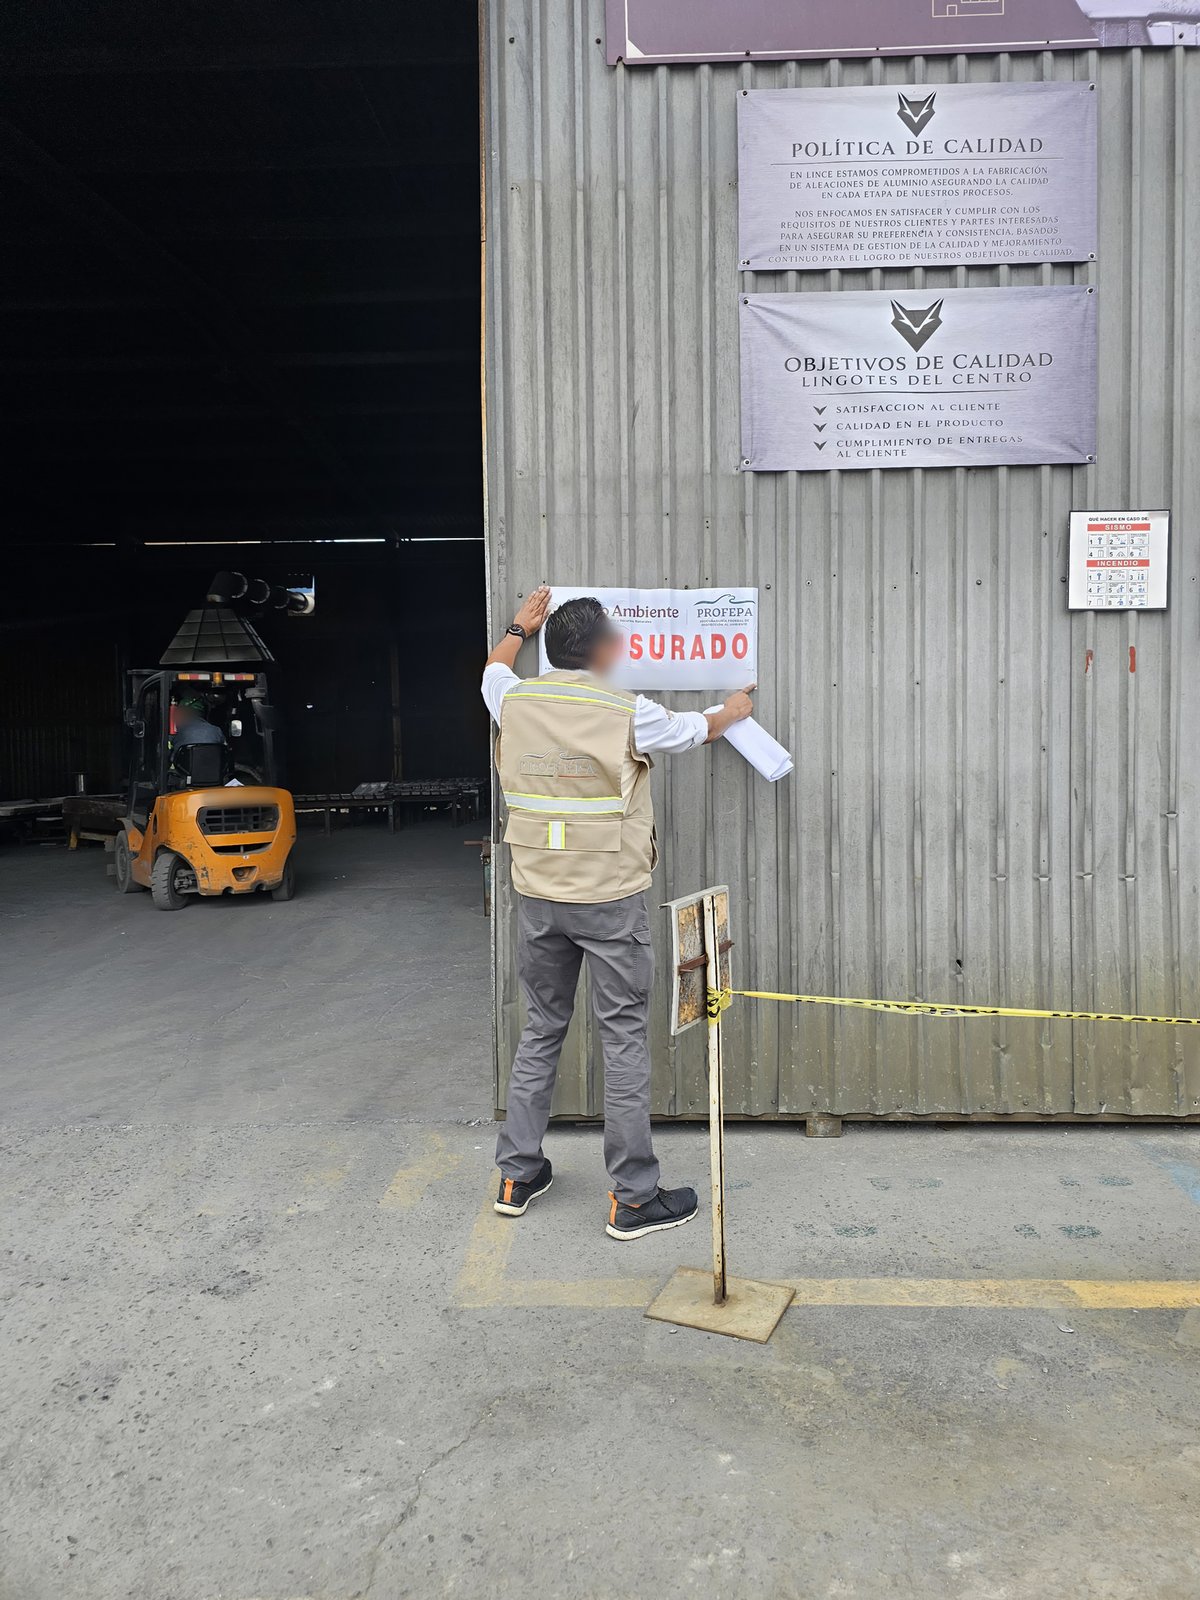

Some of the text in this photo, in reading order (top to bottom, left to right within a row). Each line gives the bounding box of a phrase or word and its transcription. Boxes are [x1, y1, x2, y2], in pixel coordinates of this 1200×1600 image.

[792, 137, 1043, 158] POLÍTICA DE CALIDAD
[790, 171, 802, 179] EN
[806, 170, 833, 179] LINCE
[836, 169, 878, 178] ESTAMOS
[881, 167, 960, 177] COMPROMETIDOS
[972, 167, 984, 175] LA
[988, 165, 1048, 175] FABRICACIÓN
[789, 182, 801, 190] DE
[805, 180, 864, 189] ALEACIONES
[883, 179, 928, 187] ALUMINIO
[931, 178, 992, 186] ASEGURANDO
[1010, 177, 1049, 185] CALIDAD
[836, 191, 861, 199] CADA
[864, 190, 893, 198] ETAPA
[911, 189, 960, 197] NUESTROS
[963, 188, 1013, 196] PROCESOS.
[795, 210, 814, 218] NOS
[817, 209, 873, 217] ENFOCAMOS
[875, 209, 888, 217] EN
[890, 207, 942, 216] SATISFACER
[955, 207, 997, 215] CUMPLIR
[1023, 206, 1040, 214] LOS
[780, 220, 836, 230] REQUISITOS
[839, 220, 851, 228] DE
[854, 219, 901, 228] NUESTROS
[904, 219, 948, 227] CLIENTES
[960, 217, 995, 226] PARTES
[998, 216, 1059, 225] INTERESADAS
[780, 232, 804, 240] PARA
[806, 231, 854, 240] ASEGURAR
[857, 231, 869, 239] SU
[872, 230, 934, 239] PREFERENCIA
[1016, 227, 1059, 235] BASADOS
[779, 244, 791, 252] EN
[794, 244, 807, 252] UN
[810, 243, 850, 252] SISTEMA
[867, 242, 907, 250] GESTION
[924, 241, 936, 249] LA
[939, 240, 980, 249] CALIDAD
[991, 238, 1062, 247] MEJORAMIENTO
[768, 255, 819, 263] CONTINUO
[863, 253, 896, 261] LOGRO
[914, 251, 961, 260] NUESTROS
[965, 250, 1015, 258] OBJETIVOS
[1018, 249, 1030, 257] DE
[784, 352, 1053, 373] OBJETIVOS DE CALIDAD
[802, 371, 1032, 388] LINGOTES DEL CENTRO
[836, 403, 1000, 414] SATISFACCION AL CLIENTE
[836, 419, 1004, 430] CALIDAD EN EL PRODUCTO
[836, 435, 1023, 448] CUMPLIMIENTO DE ENTREGAS
[836, 449, 907, 458] AL CLIENTE
[612, 604, 679, 618] Ambiente
[697, 607, 753, 618] PROFEPA
[629, 632, 748, 661] SURADO
